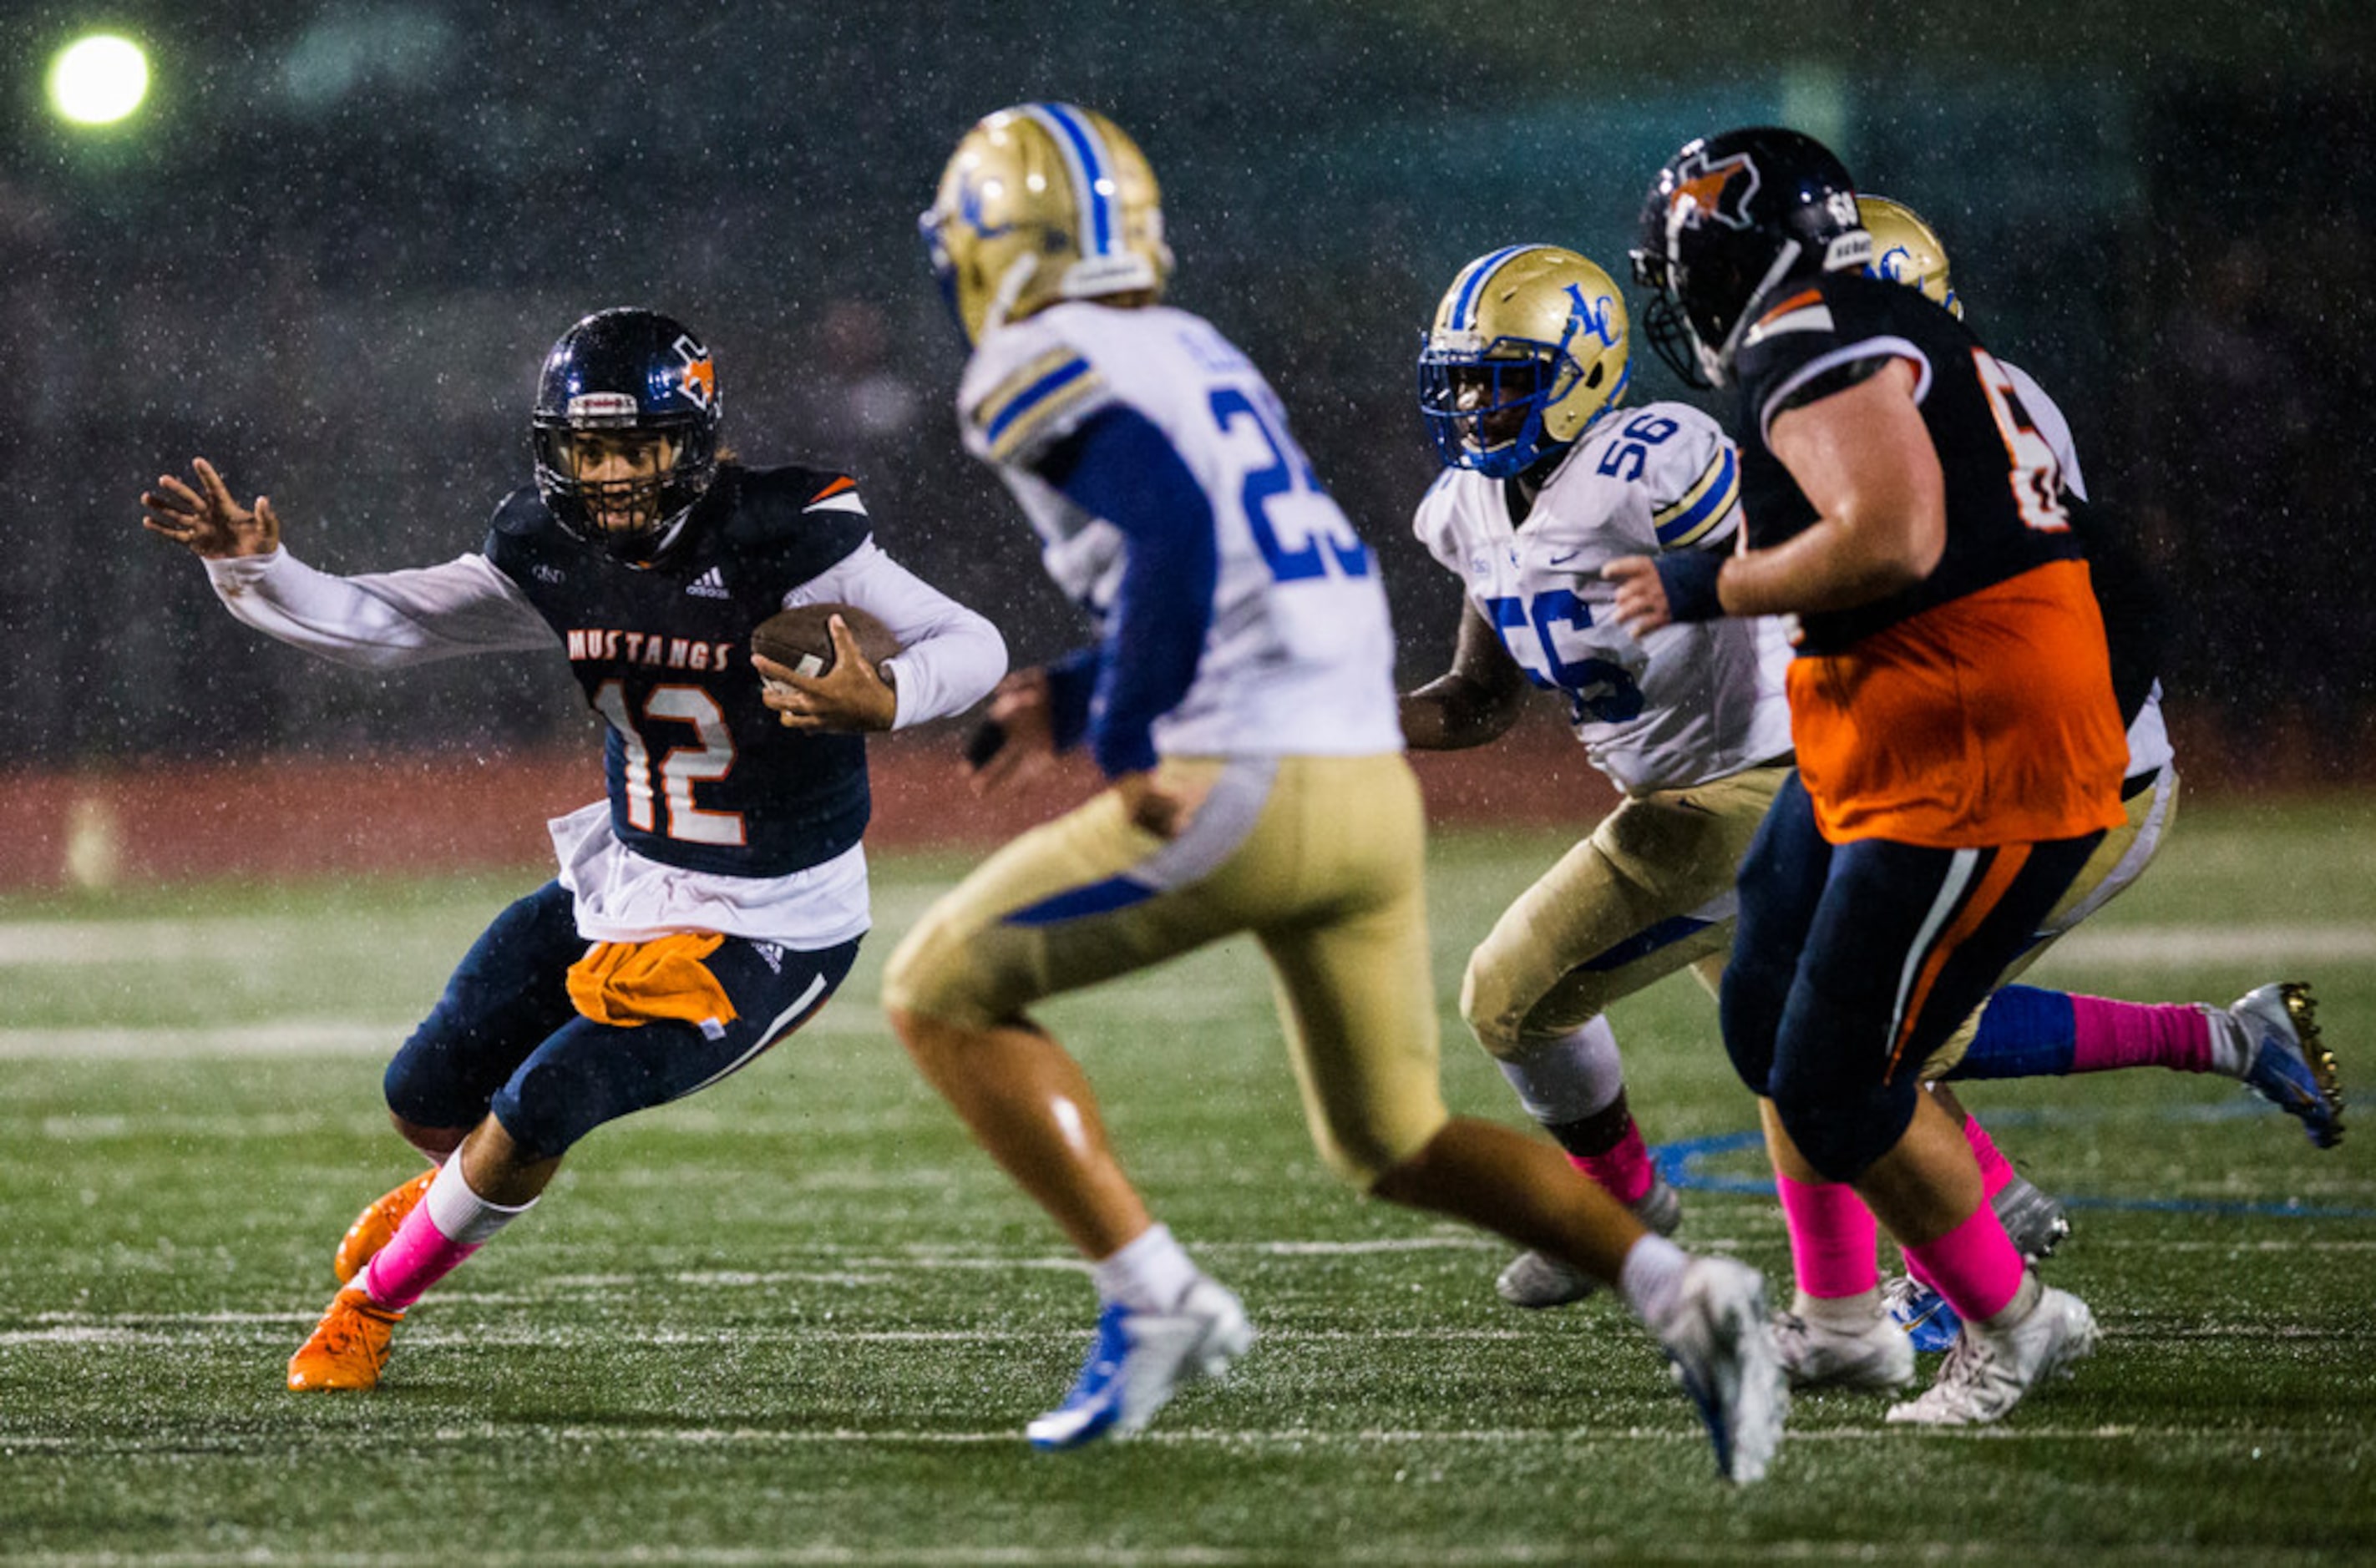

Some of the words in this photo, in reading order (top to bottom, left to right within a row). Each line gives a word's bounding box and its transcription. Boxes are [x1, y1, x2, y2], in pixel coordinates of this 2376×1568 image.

[1561, 282, 1623, 348] AC
[1596, 414, 1679, 483] 56
[567, 629, 733, 671] MUSTANGS
[1484, 589, 1645, 726] 56
[592, 677, 747, 847] 12
